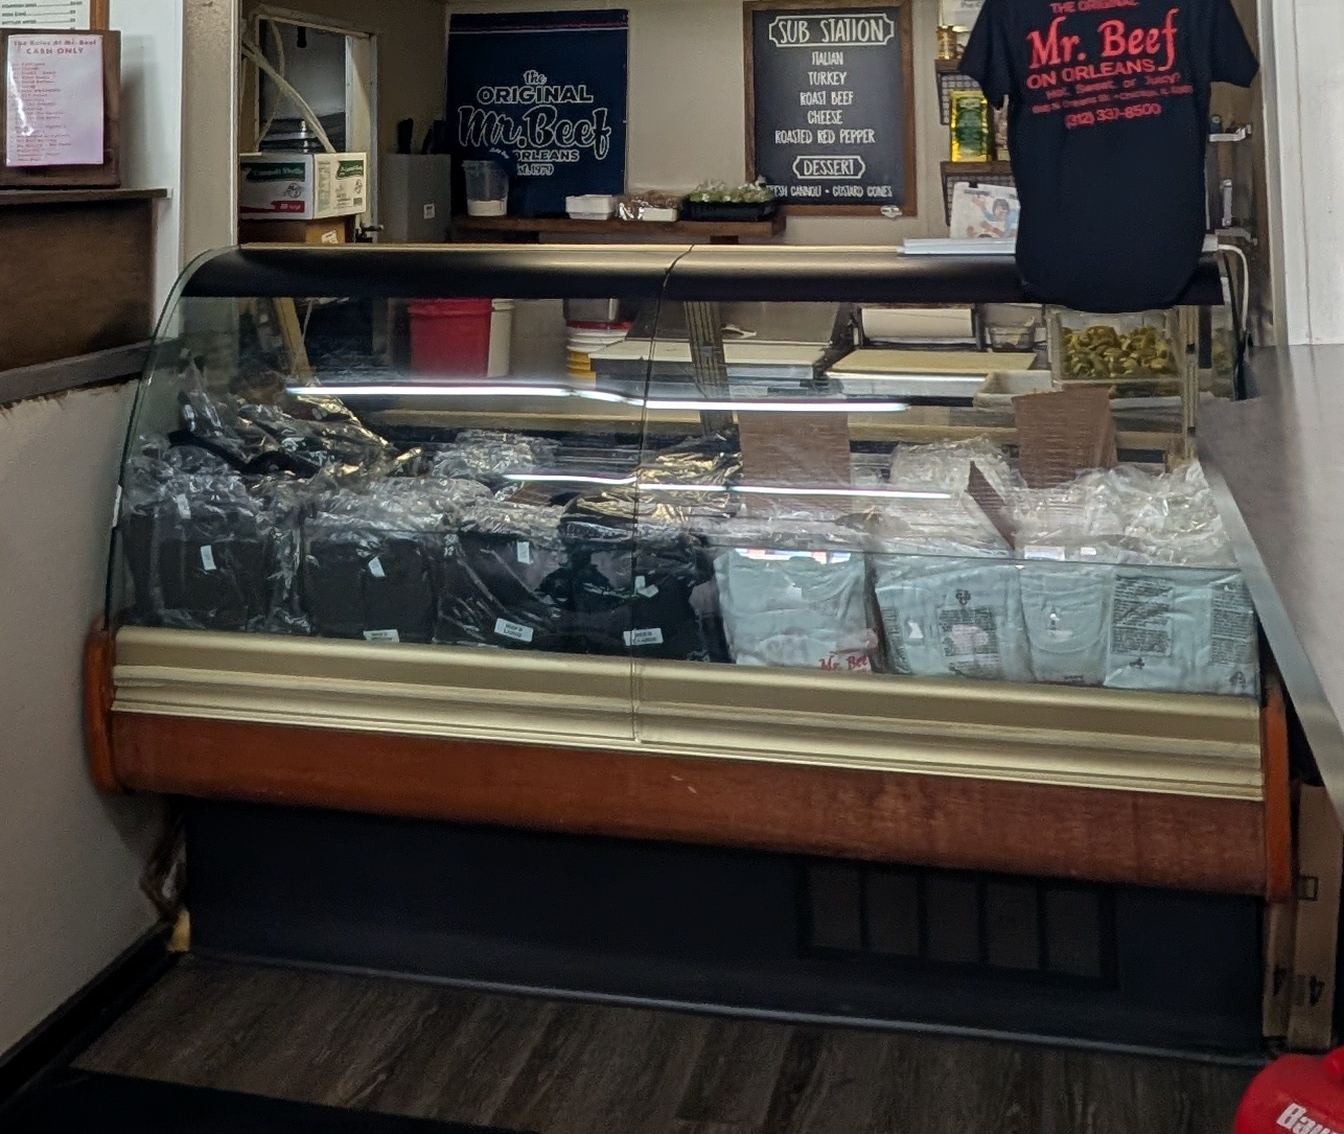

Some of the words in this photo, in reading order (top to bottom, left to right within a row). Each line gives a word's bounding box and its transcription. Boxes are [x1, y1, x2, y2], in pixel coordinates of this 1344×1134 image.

[1049, 1, 1075, 15] THE
[778, 20, 810, 44] SUB
[820, 18, 884, 43] STATION
[1025, 16, 1088, 69] Mr.
[1097, 7, 1180, 72] Beef
[811, 51, 844, 66] ITALIAN
[807, 71, 847, 86] TURKEY
[1026, 70, 1057, 90] ON
[1061, 58, 1156, 83] ORLEANS
[476, 84, 594, 105] ORIGINAL
[800, 91, 827, 106] ROAST
[831, 91, 854, 106] BEEF
[807, 110, 843, 125] CHEESE
[774, 129, 813, 144] ROASTED
[817, 129, 836, 144] RED
[839, 128, 876, 144] PEPPER
[803, 159, 855, 175] DESSERT
[866, 185, 893, 198] CONES
